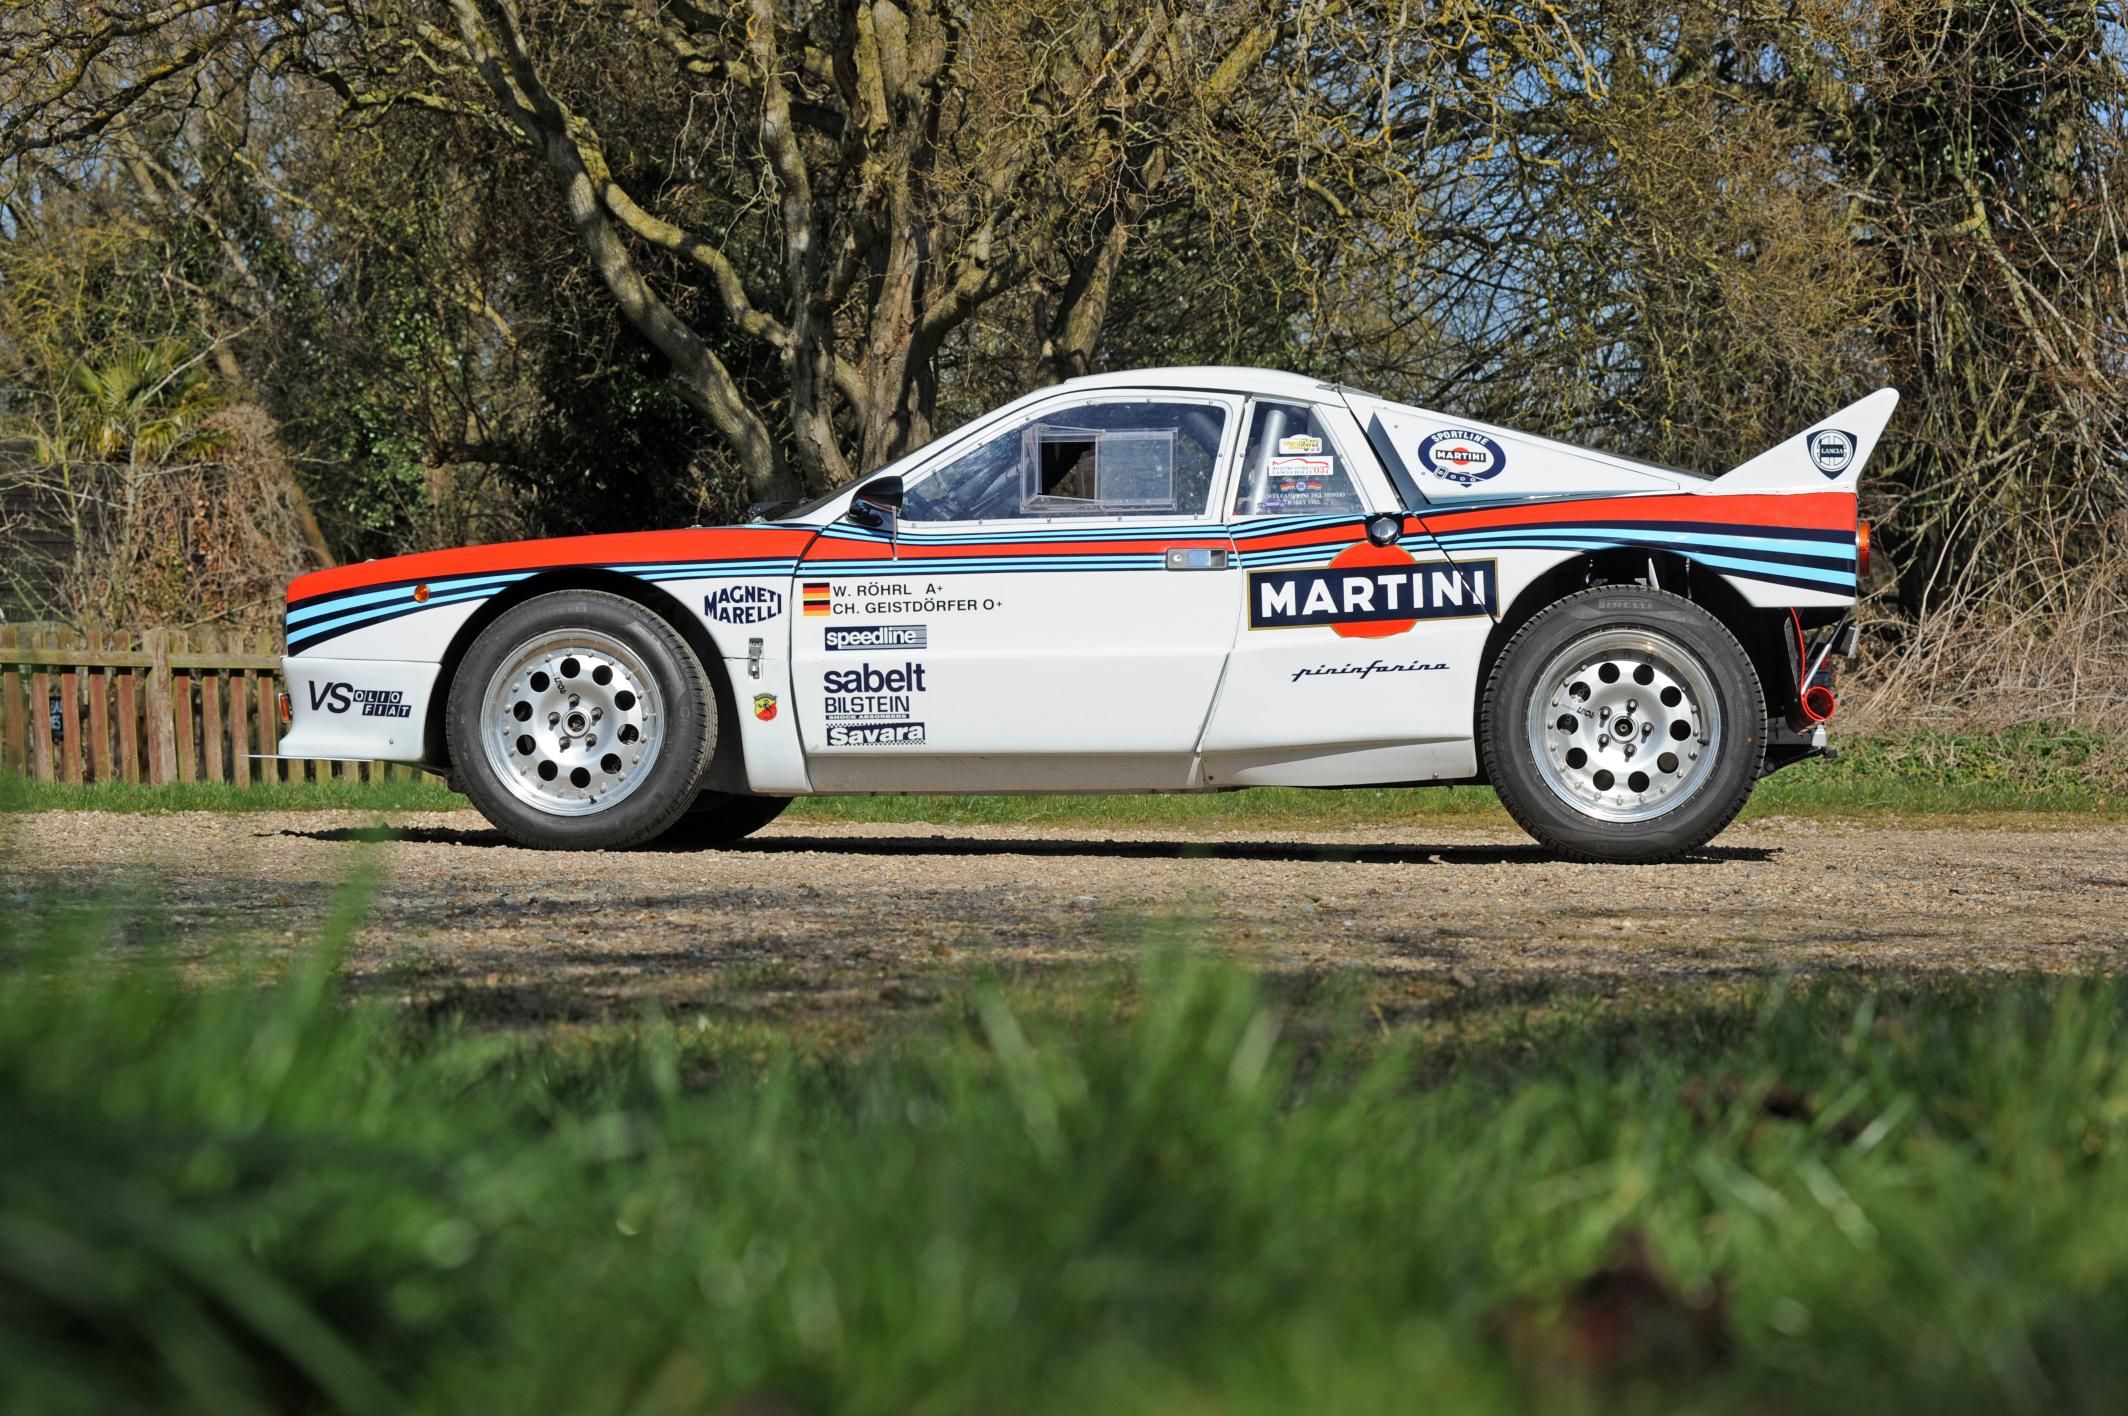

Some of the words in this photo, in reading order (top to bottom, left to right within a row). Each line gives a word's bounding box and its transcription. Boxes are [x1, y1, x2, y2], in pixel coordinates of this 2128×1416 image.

[1431, 431, 1489, 445] SPORTLINE
[1437, 451, 1485, 461] MARTINI
[704, 586, 782, 606] MAGNETI
[833, 586, 851, 597] W.
[857, 582, 912, 596] RÖHRL
[926, 583, 943, 594] A+
[1260, 570, 1486, 618] MARTINI
[704, 604, 782, 624] MARELLI
[833, 602, 860, 614] CH.
[865, 598, 977, 613] GEISTDÖRFER
[826, 627, 917, 649] speedline
[824, 662, 926, 693] sabelt
[1291, 660, 1450, 682] pininfarina
[309, 680, 353, 714] VS
[355, 691, 401, 702] OLIO
[825, 696, 909, 713] BILSTEIN
[364, 704, 410, 716] FIAT
[830, 726, 923, 746] Savara
